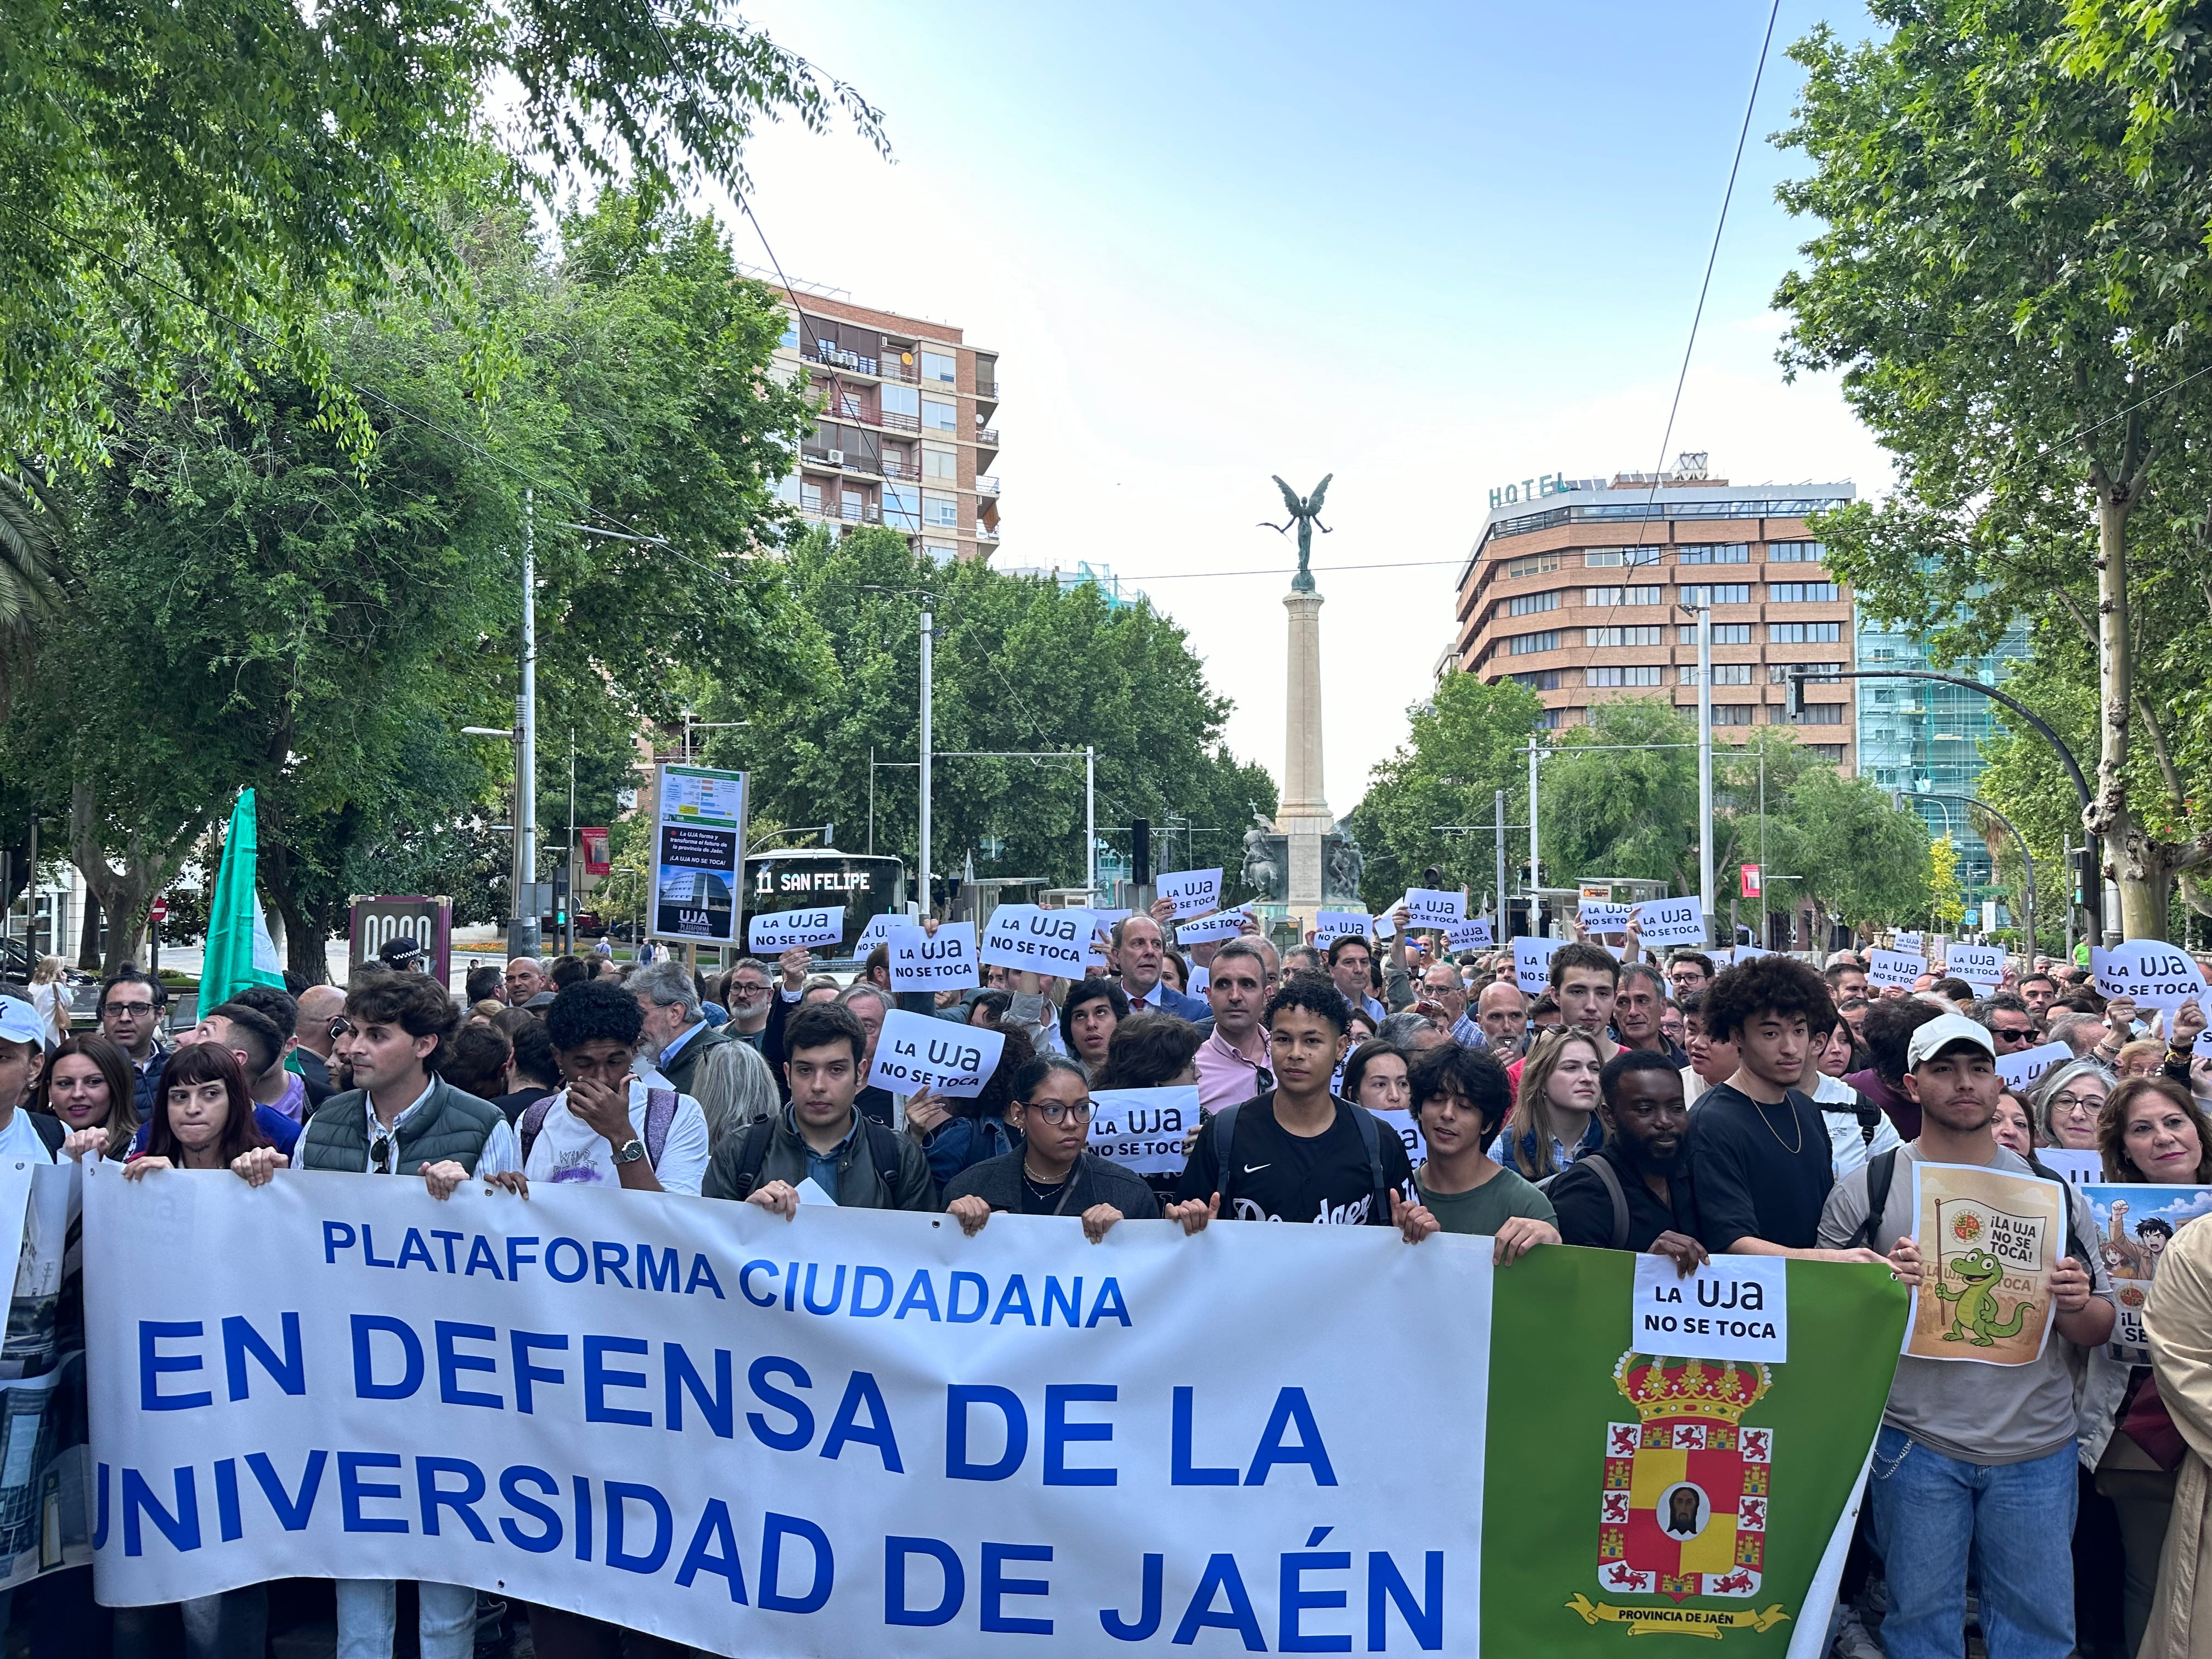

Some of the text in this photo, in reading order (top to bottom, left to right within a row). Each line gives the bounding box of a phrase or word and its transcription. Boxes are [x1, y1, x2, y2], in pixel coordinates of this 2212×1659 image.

[1489, 472, 1570, 509] HOTEL
[678, 845, 702, 853] provincia
[756, 872, 870, 894] 11 SAN FELIPE
[1193, 896, 1215, 906] TOCA
[679, 910, 709, 924] UJA
[763, 920, 779, 928] LA
[680, 922, 710, 933] PLATAFORMA
[1002, 919, 1019, 930] LA
[1203, 921, 1216, 929] SE
[1674, 925, 1700, 934] TOCA
[756, 934, 836, 945] NO SE TOCA
[900, 949, 914, 959] LA
[990, 937, 1013, 950] NO
[1017, 940, 1035, 953] SE
[1039, 945, 1080, 962] TOCA
[1525, 957, 1537, 965] LA
[896, 964, 972, 977] NO SE TOCA
[1521, 971, 1535, 980] NO
[2108, 966, 2129, 977] LA
[2100, 979, 2199, 995] NO SE TOCA
[895, 1040, 915, 1057] LA
[880, 1062, 979, 1087] NO SE TOCA
[2007, 1075, 2020, 1086] LA
[1096, 1120, 1117, 1135] LA
[1119, 1142, 1139, 1155] SE
[1990, 1216, 2035, 1238] ¡LA UJA
[1992, 1230, 2031, 1250] NO SE
[1990, 1241, 2032, 1262] TOCA!
[323, 1220, 1132, 1328] PLATAFORMA CIUDADANA
[1655, 1286, 1682, 1303] LA
[1645, 1314, 1776, 1339] NO SE TOCA
[138, 1312, 1339, 1487] EN DEFENSA DE LA
[884, 1534, 1054, 1636] DE
[1099, 1525, 1444, 1654] JAÉN
[1618, 1609, 1734, 1625] PROVINCIA DE JAÉN
